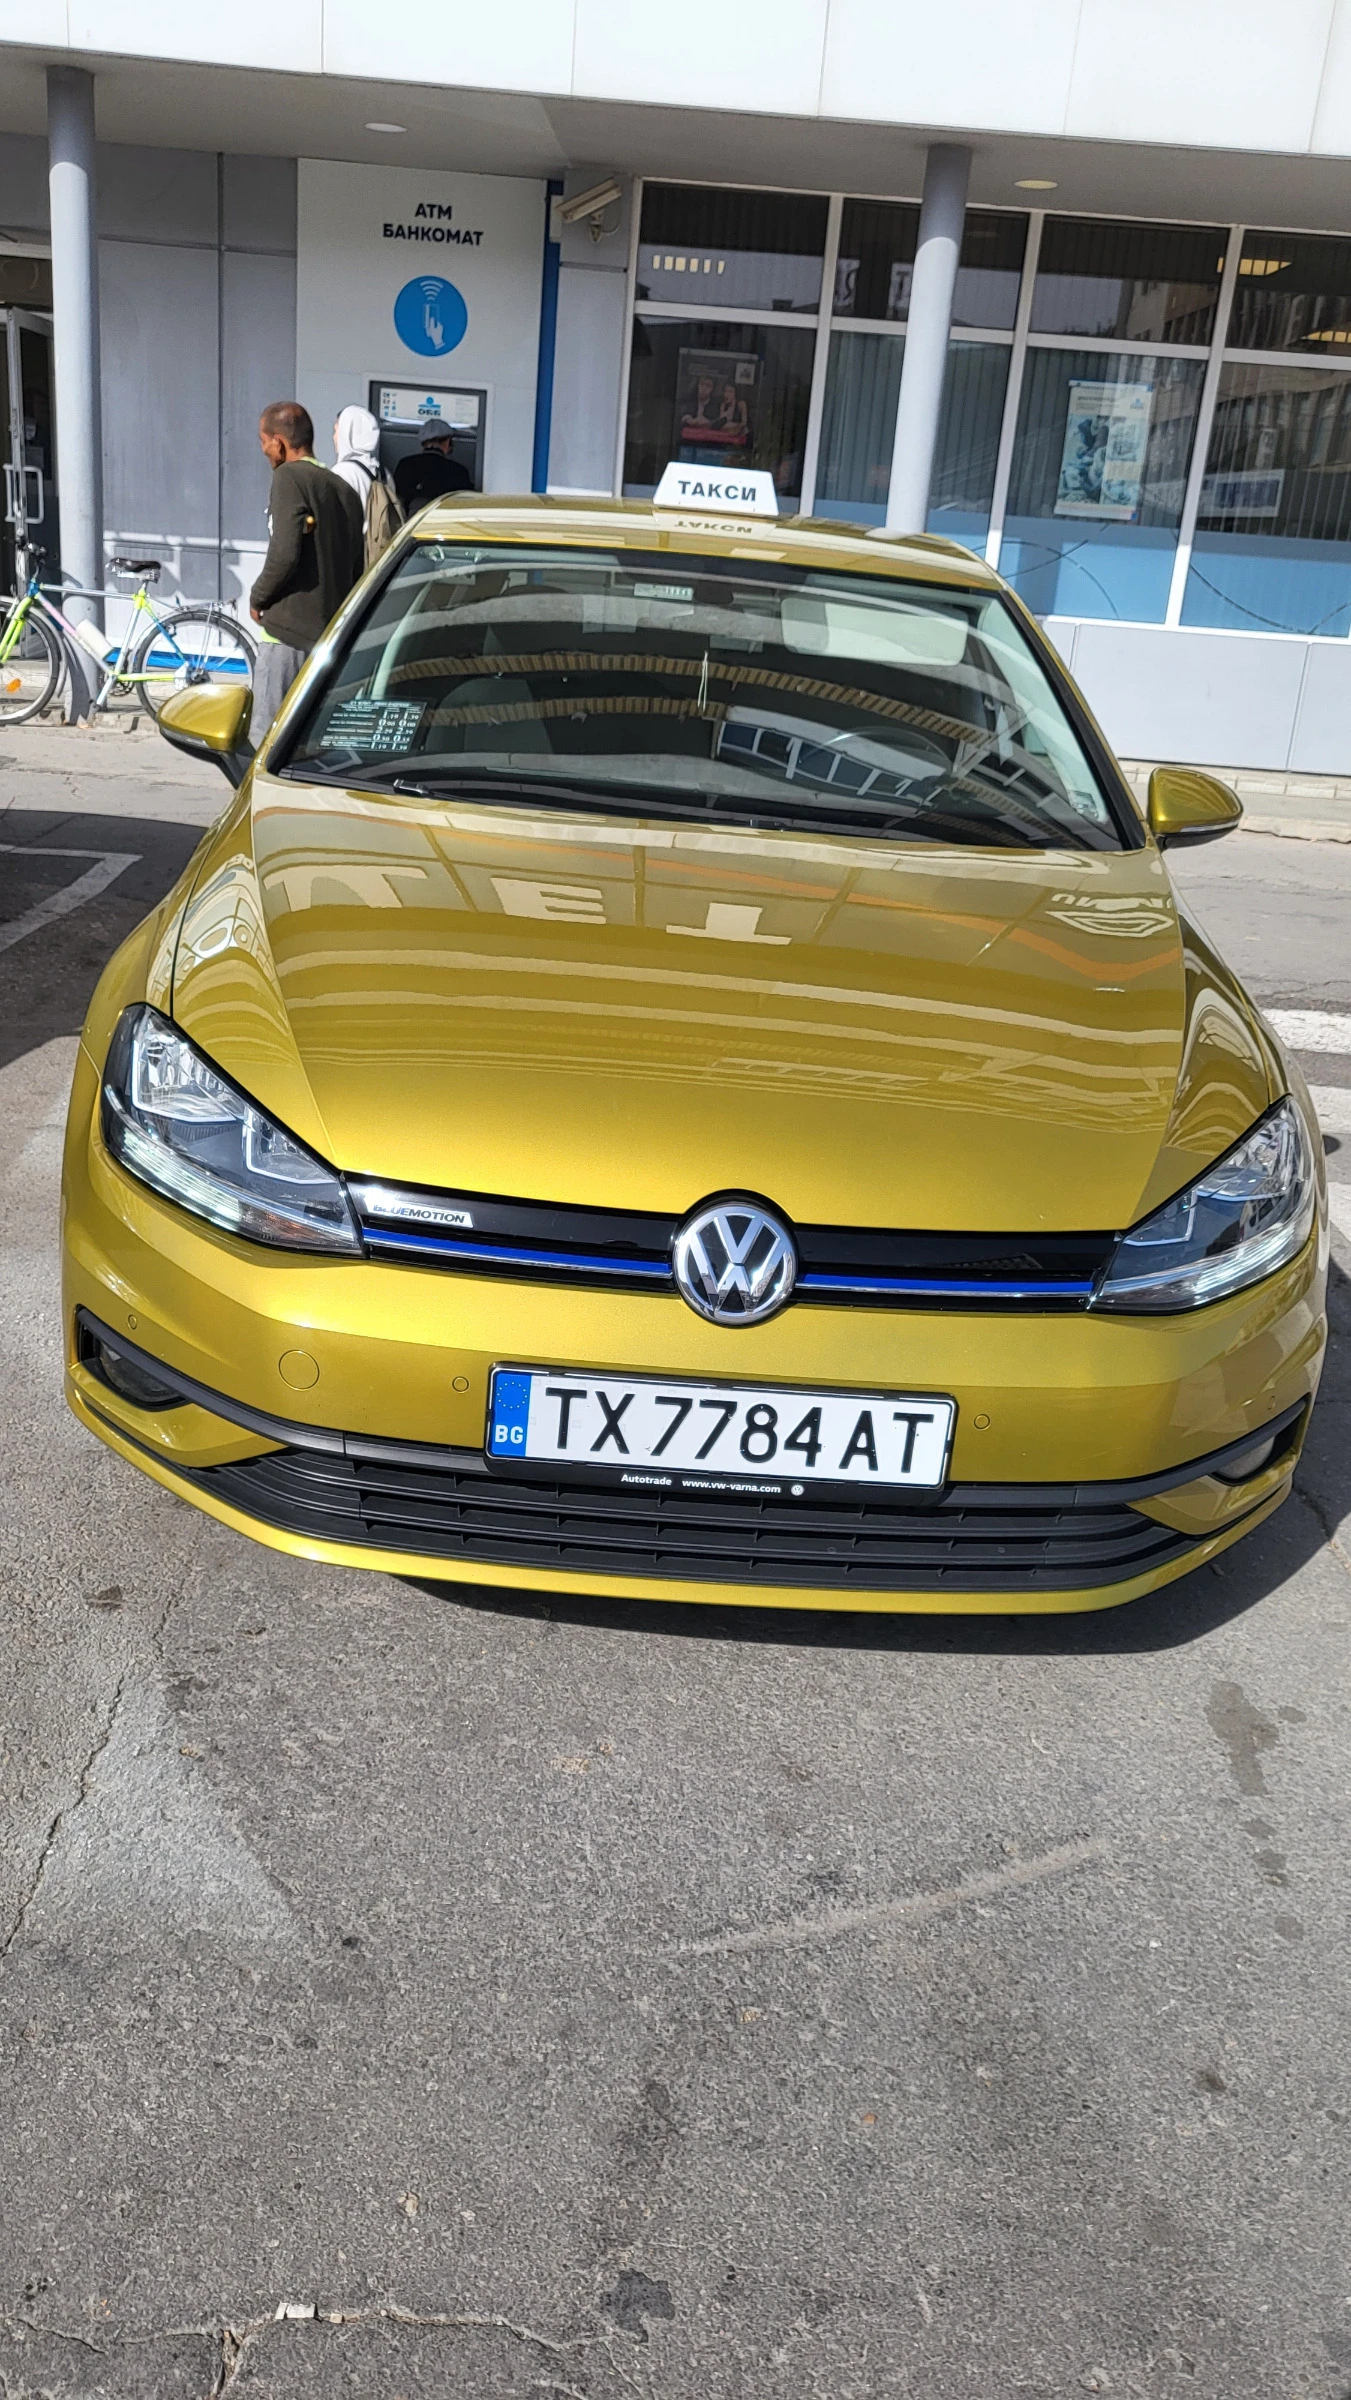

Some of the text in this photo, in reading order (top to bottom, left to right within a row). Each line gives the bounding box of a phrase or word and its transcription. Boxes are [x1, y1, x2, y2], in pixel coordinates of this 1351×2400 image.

[383, 223, 484, 246] БАНКОМАТ
[678, 480, 756, 502] ТАКСИ
[495, 1424, 523, 1444] BG
[620, 1474, 672, 1486] Autotrade
[682, 1479, 781, 1494] www.vw-varna.com
